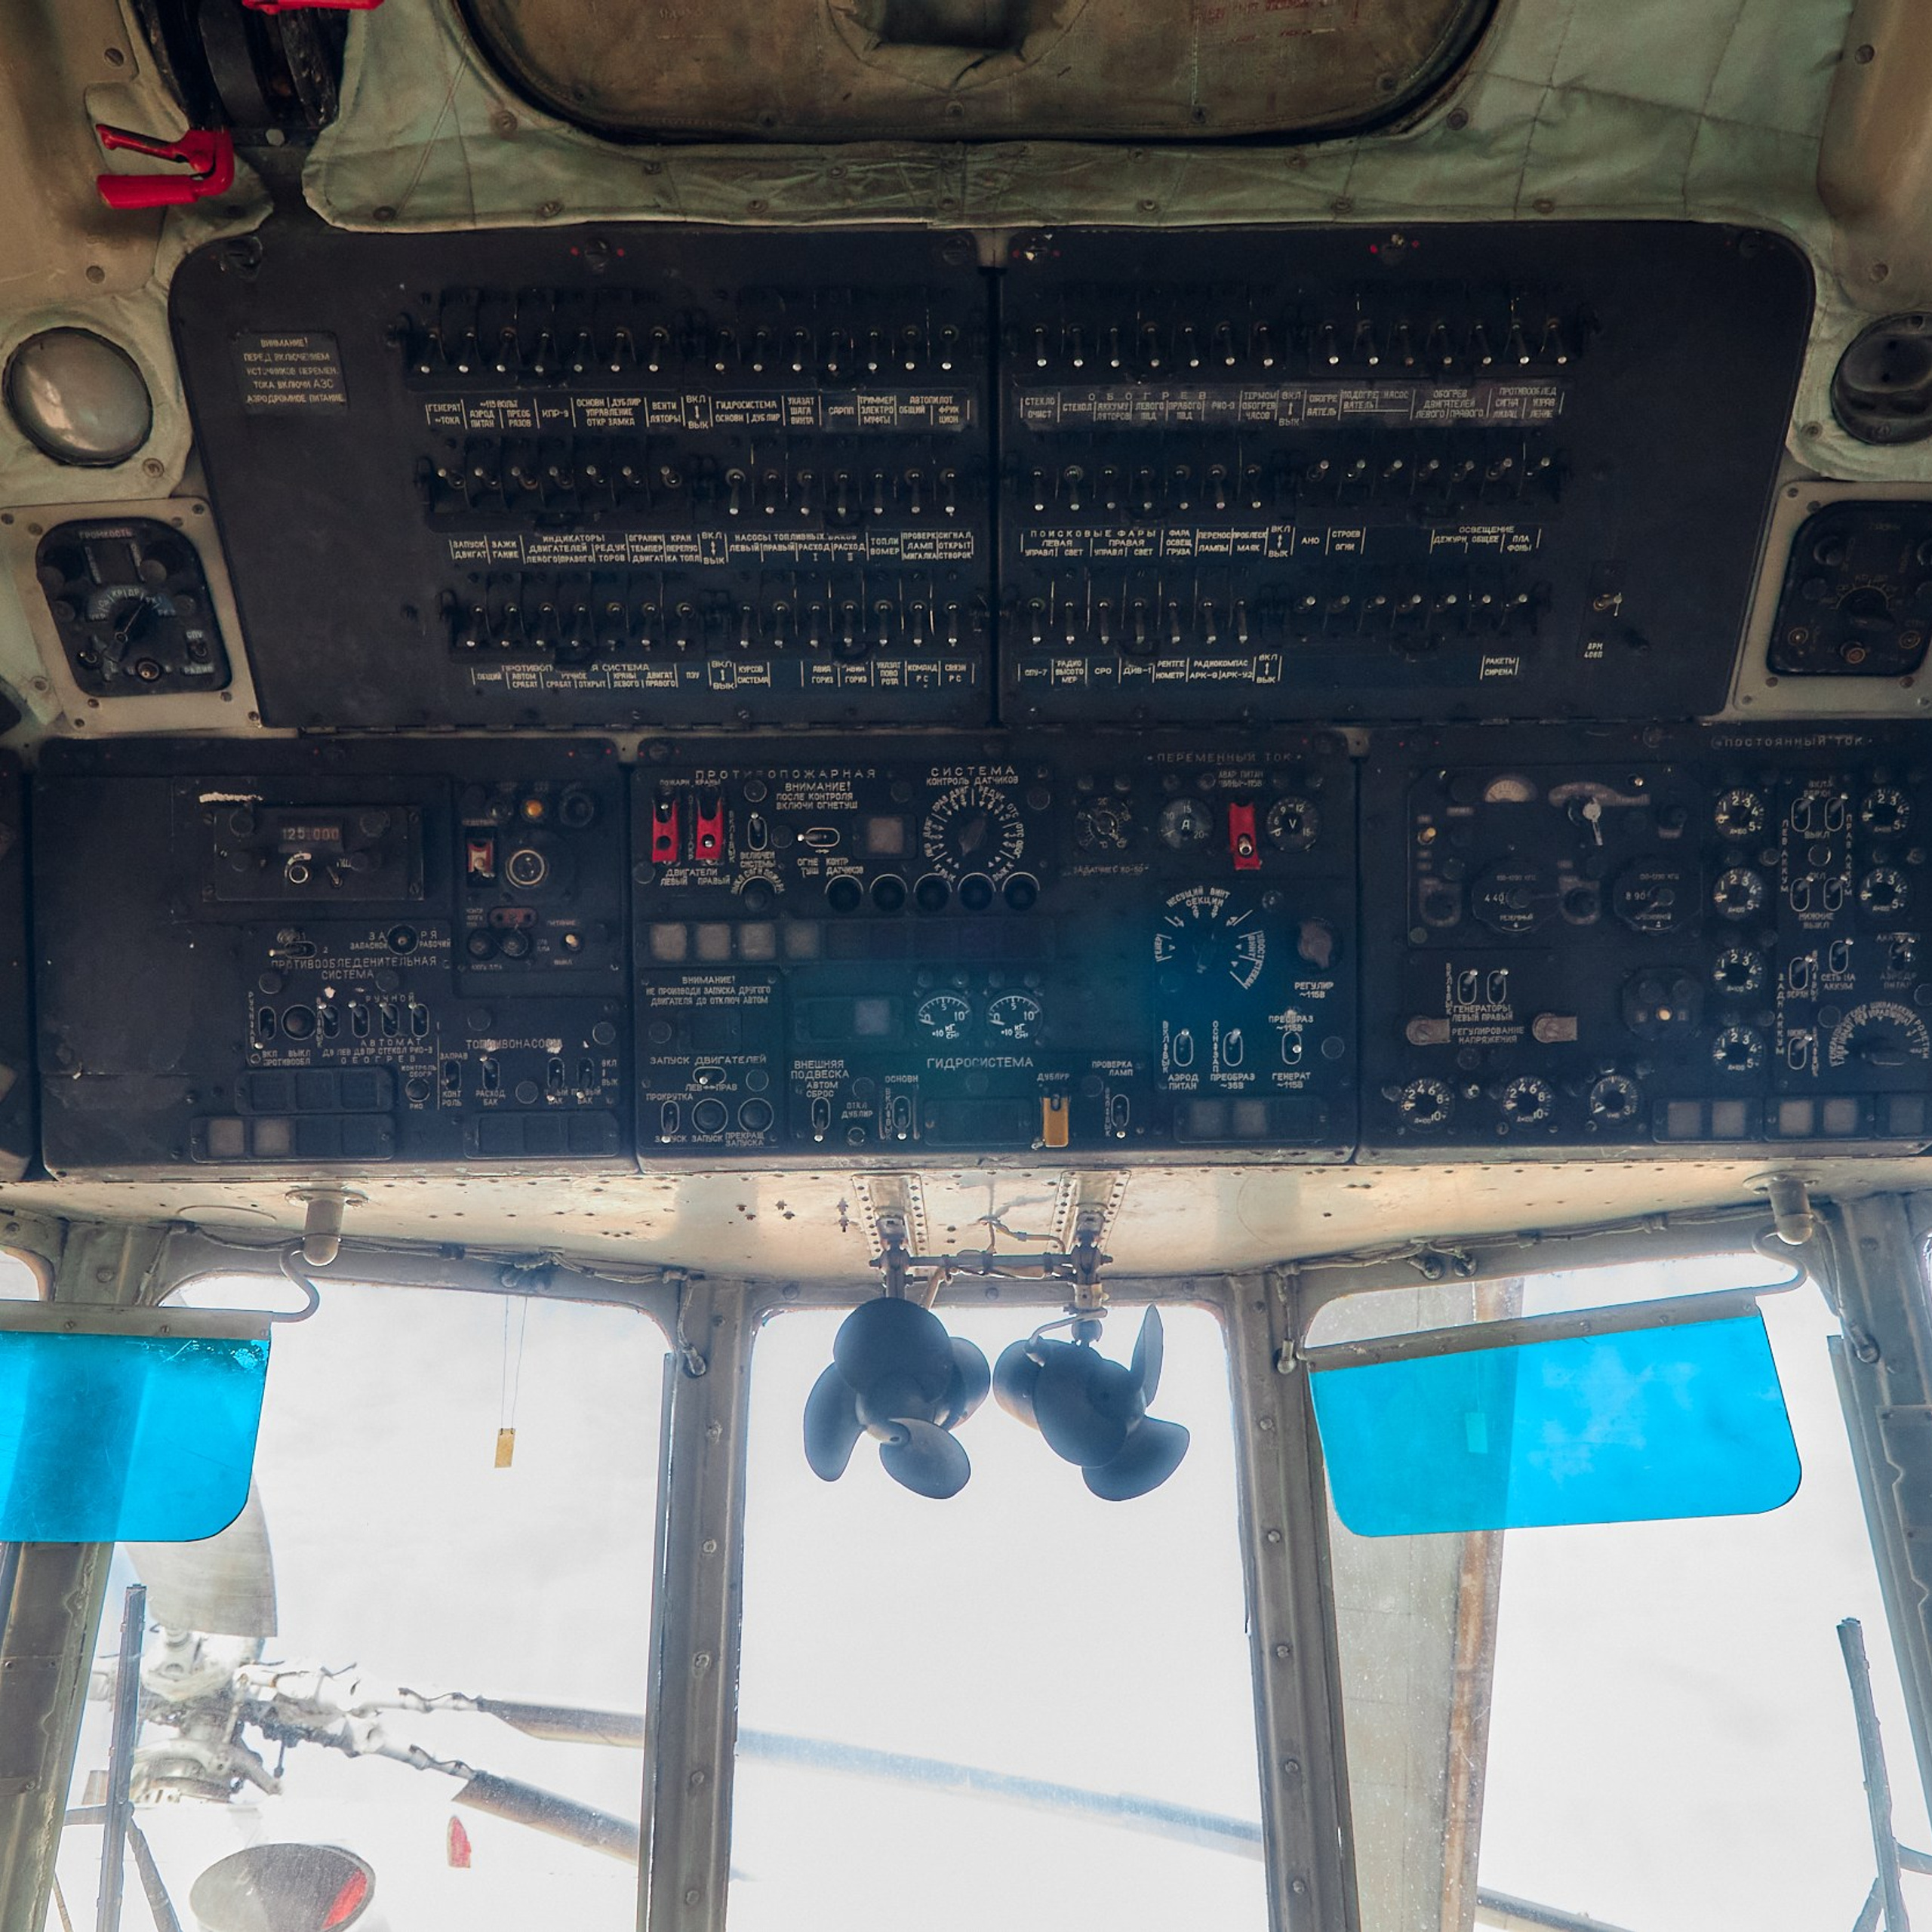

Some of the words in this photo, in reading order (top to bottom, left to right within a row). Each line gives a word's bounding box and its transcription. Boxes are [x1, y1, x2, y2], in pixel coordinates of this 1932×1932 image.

[686, 395, 706, 403] ВКЛ
[716, 400, 777, 411] ГИДРОСИСТЕМА
[688, 420, 709, 429] ВЫК
[1168, 529, 1190, 538] ФАРА
[1271, 525, 1290, 534] ВКЛ
[1459, 526, 1514, 535] ОСВЕЩЕНИЕ
[543, 534, 605, 544] ИНДИКАТОРЫ
[671, 534, 692, 543] КРАН
[702, 531, 723, 541] ВКЛ
[734, 533, 771, 542] НАСОСЫ
[939, 531, 972, 540] СИГНАЛ
[1030, 530, 1111, 539] ПОИСКОВЫЕ
[1118, 530, 1156, 539] ФАРЫ
[1331, 530, 1360, 539] СТРОЕВ
[1512, 534, 1530, 543] ПЛА
[870, 538, 899, 546] ТОПЛИ
[938, 542, 971, 550] ОТКРЫТ
[1042, 539, 1072, 548] ЛЕВАЯ
[1109, 539, 1145, 548] ПРАВАЯ
[1165, 539, 1192, 549] ОСВЕЩ
[1301, 537, 1319, 546] АНО
[529, 543, 587, 554] ДВИГАТЕЛЕЙ
[595, 543, 625, 553] РЕДУК
[729, 543, 760, 552] ЛЕВЫЙ
[763, 543, 795, 552] ПРАВЫЙ
[798, 543, 831, 552] РАСХОД
[833, 543, 866, 552] РАСХОД
[870, 548, 899, 556] ВОМЕР
[1199, 544, 1228, 553] ЛАМПЫ
[938, 552, 971, 561] СТВОРОК
[1025, 549, 1054, 558] УПРАВЛ
[1063, 549, 1083, 557] СВЕТ
[1134, 549, 1153, 557] СВЕТ
[1166, 549, 1191, 557] ГРУЗА
[1269, 550, 1288, 558] ВЫК
[598, 554, 626, 562] ТОРОВ
[703, 555, 725, 565] ВЫК
[1258, 654, 1278, 662] ВКЛ
[1484, 657, 1517, 666] РАКЕТЫ
[601, 663, 649, 672] СИСТЕМА
[712, 660, 732, 669] ВКЛ
[1194, 660, 1248, 670] РАДИОКОМПАС
[1094, 667, 1112, 675] СРО
[1155, 671, 1185, 679] НОМЕТР
[1256, 676, 1276, 685] ВЫК
[713, 682, 735, 691] ВЫК
[1724, 737, 1826, 747] ПОСТОЯННЫЙ
[1157, 753, 1257, 762] ПЕРЕМЕННЫЙ
[1267, 753, 1292, 761] ТОК
[931, 765, 1015, 777] СИСТЕМА
[926, 777, 970, 786] КОНТРОЛЬ
[974, 775, 1019, 786] ДАТЧИКОВ
[785, 782, 851, 792] ВНИМАНИЕ!
[776, 792, 804, 801] ПОСЛЕ
[808, 792, 853, 801] КОНТРОЛЯ
[776, 801, 812, 811] ВКЛЮЧИ
[817, 801, 857, 810] ОГНЕТУШ
[796, 858, 817, 867] ОГНЕ
[666, 868, 717, 878] ДВИГАТЕЛИ
[660, 876, 688, 886] ЛЕВЫЙ
[697, 875, 730, 885] ПРАВЫЙ
[321, 970, 374, 980] СИСТЕМА
[681, 975, 735, 985] ВНИМАНИЕ!
[1453, 1004, 1512, 1014] ГЕНЕРАТОРЫ
[1452, 1027, 1524, 1036] РЕГУЛИРОВАНИЕ
[361, 1038, 422, 1048] АВТОМАТ
[1459, 1035, 1518, 1044] НАПРЯЖЕНИЯ
[650, 1057, 690, 1065] ЗАПУСК
[694, 1054, 767, 1066] ДВИГАТЕЛЕЙ
[794, 1060, 844, 1069] ВНЕШНЯЯ
[790, 1070, 850, 1081] ПОДВЕСКА
[685, 1083, 702, 1091] ЛЕВ
[715, 1083, 737, 1091] ПРАВ
[646, 1093, 694, 1101] ПРОКРУТКА
[725, 1132, 764, 1141] ПРЕКРАЩ
